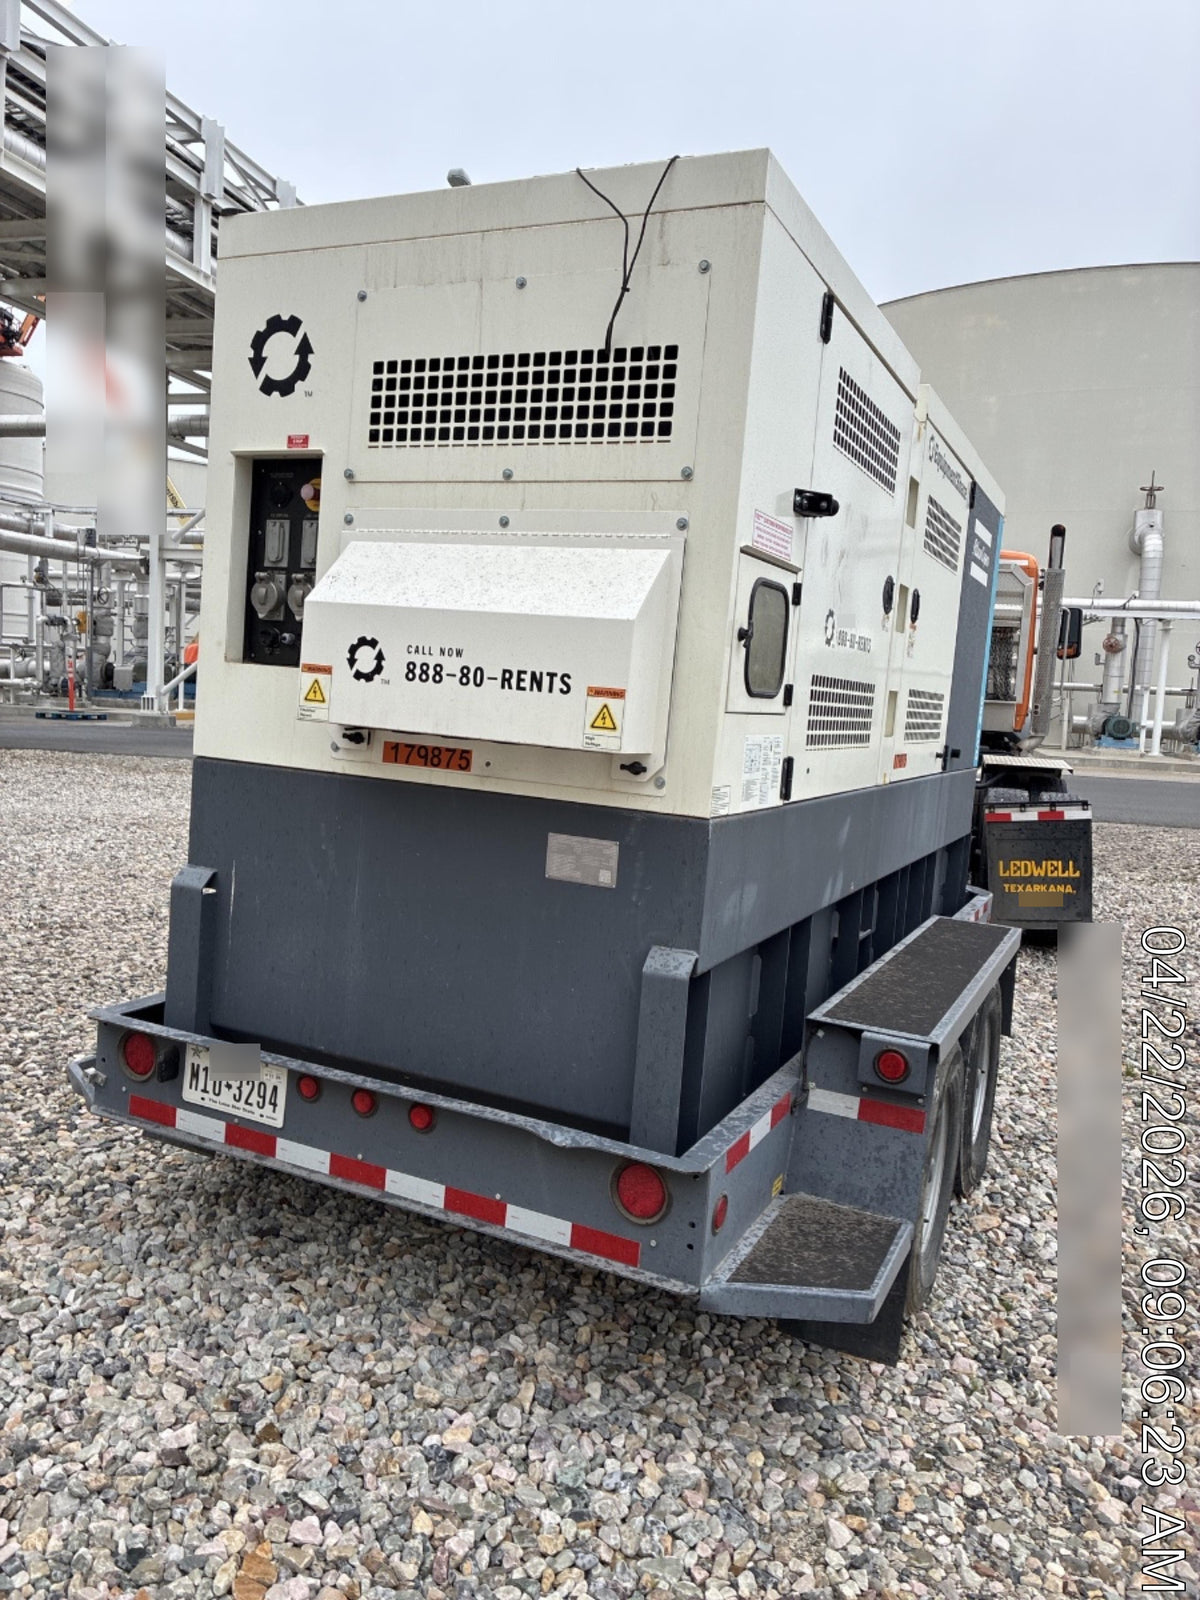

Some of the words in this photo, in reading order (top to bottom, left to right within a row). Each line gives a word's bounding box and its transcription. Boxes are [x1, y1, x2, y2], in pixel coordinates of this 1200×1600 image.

[406, 644, 433, 656] CALL
[439, 647, 464, 658] NOW
[404, 661, 572, 695] 888-80-RENTS
[391, 743, 471, 771] 179875
[999, 860, 1081, 877] LEDWELL
